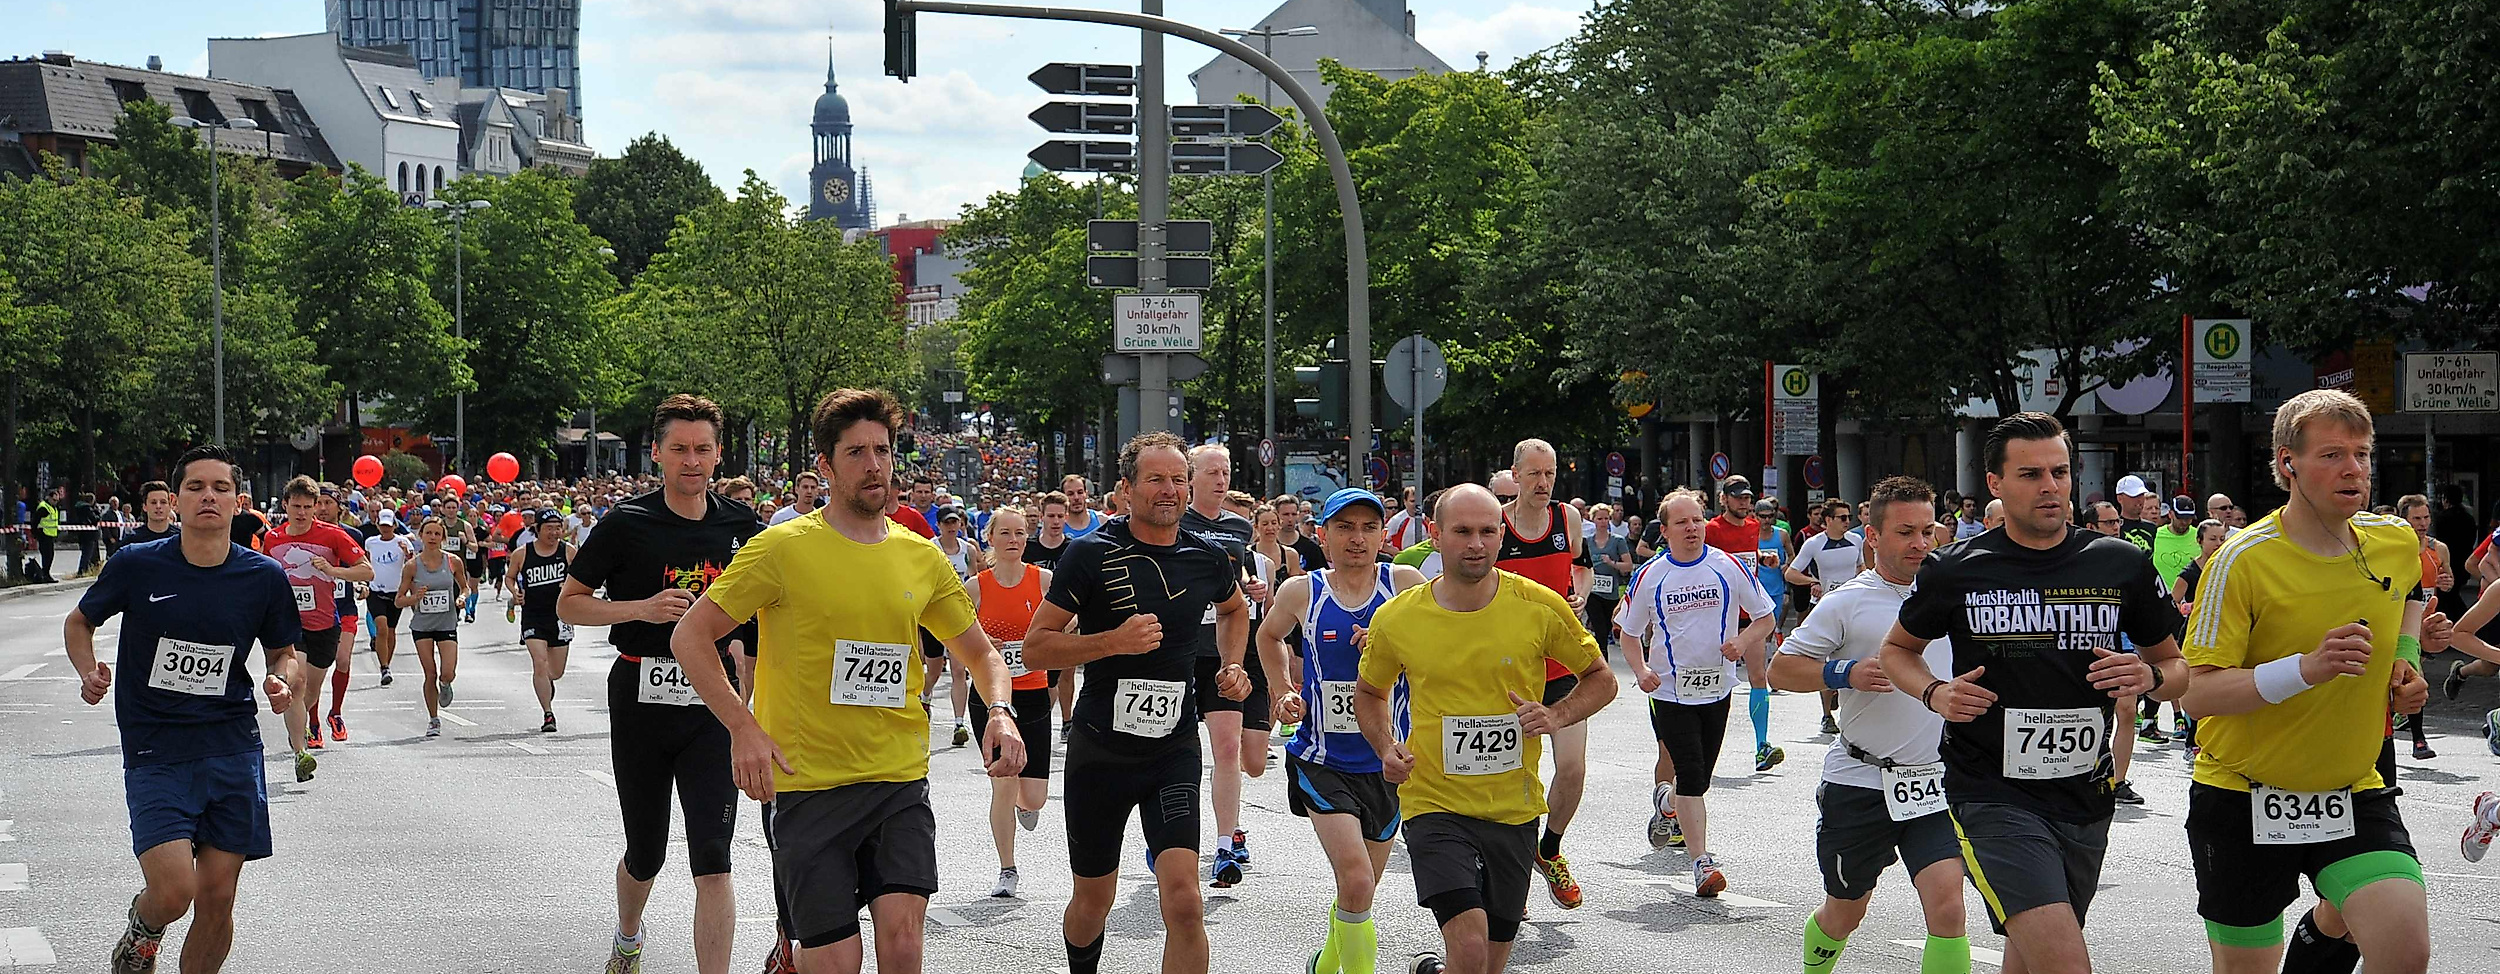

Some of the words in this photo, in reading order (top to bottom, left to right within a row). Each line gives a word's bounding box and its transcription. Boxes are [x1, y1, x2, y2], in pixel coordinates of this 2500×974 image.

[1127, 310, 1189, 321] Unfallgefahr
[1136, 323, 1149, 334] 30
[1152, 323, 1181, 334] km/h
[1123, 337, 1157, 347] Grüne
[1162, 337, 1193, 347] Welle
[2418, 368, 2486, 381] Unfallgefahr
[2427, 383, 2441, 395] 30
[2444, 383, 2476, 395] km/h
[2413, 397, 2451, 408] Grüne
[2456, 396, 2491, 408] Welle
[1679, 583, 1705, 592] TEAM
[2044, 588, 2098, 597] HAMBURG
[2101, 588, 2122, 597] 2012
[422, 596, 447, 606] 6175
[1666, 589, 1720, 605] ERDINGER
[1966, 604, 2121, 634] URBANATHLON
[173, 641, 195, 653] hella
[2057, 633, 2068, 650] &
[851, 643, 875, 656] hella
[163, 652, 225, 677] 3094
[844, 657, 903, 685] 7428
[178, 674, 205, 684] Michael
[1681, 674, 1720, 687] 7481
[854, 684, 890, 693] Christoph
[1131, 681, 1153, 691] hella
[1335, 684, 1356, 692] hella
[1125, 693, 1178, 718] 7431
[1136, 716, 1167, 725] Bernhard
[2024, 712, 2053, 724] hella
[1457, 719, 1482, 729] hella
[1452, 728, 1517, 755] 7429
[2017, 726, 2096, 754] 7450
[1475, 754, 1498, 762] Micha
[2042, 756, 2070, 764] Daniel
[1897, 769, 1917, 778] hella
[2018, 766, 2037, 774] hella
[2264, 793, 2345, 821] 6346
[2288, 822, 2321, 830] Dennis
